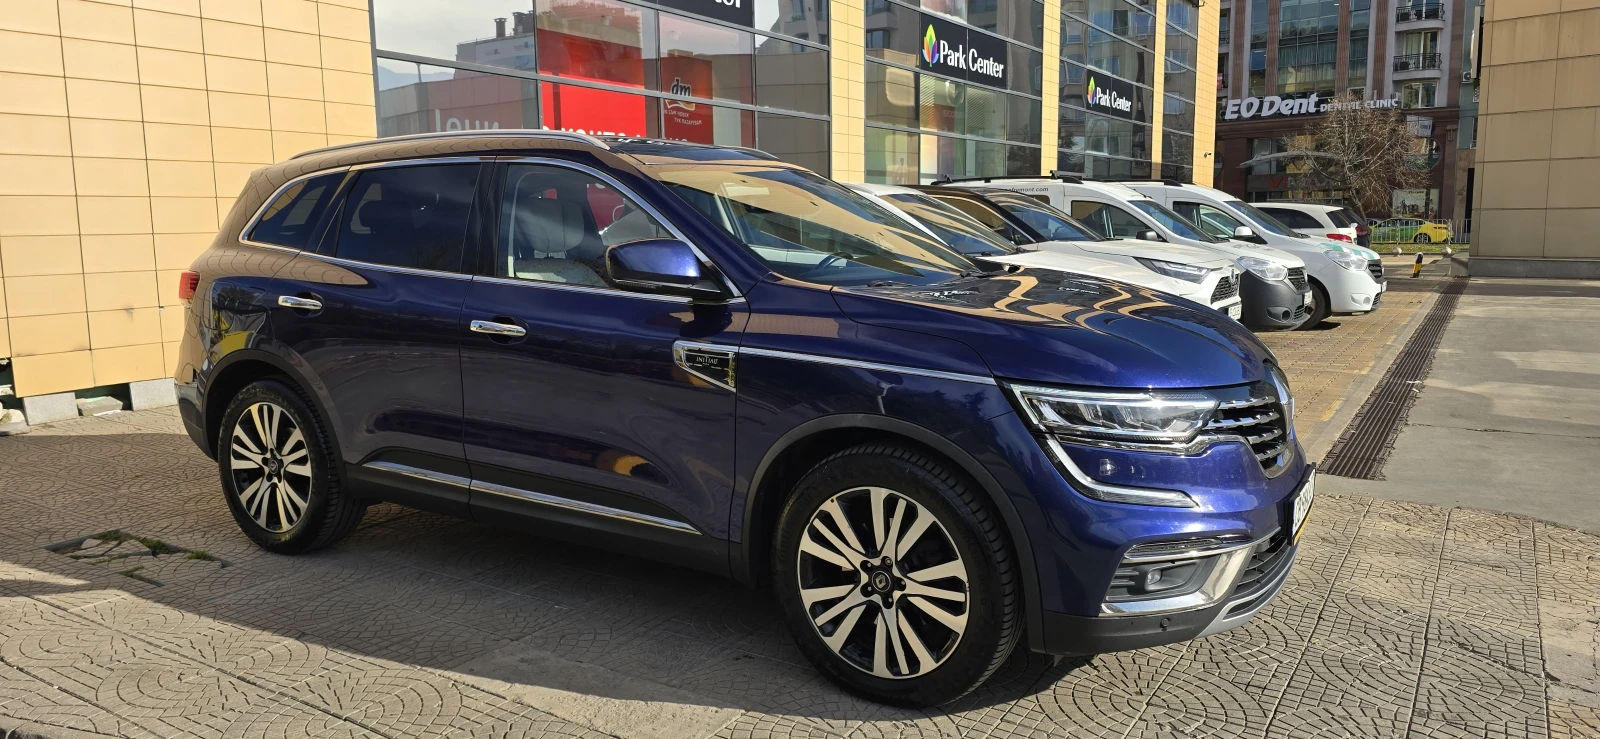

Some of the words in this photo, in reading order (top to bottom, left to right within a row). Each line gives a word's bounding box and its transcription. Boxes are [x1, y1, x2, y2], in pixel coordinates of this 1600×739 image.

[939, 39, 967, 70] Park
[968, 48, 1005, 78] Center
[671, 78, 691, 97] dm
[1096, 86, 1111, 108] Park
[1111, 90, 1132, 112] Center
[1224, 96, 1260, 120] EO
[1260, 92, 1319, 117] Dent
[1364, 98, 1399, 110] CLINIC
